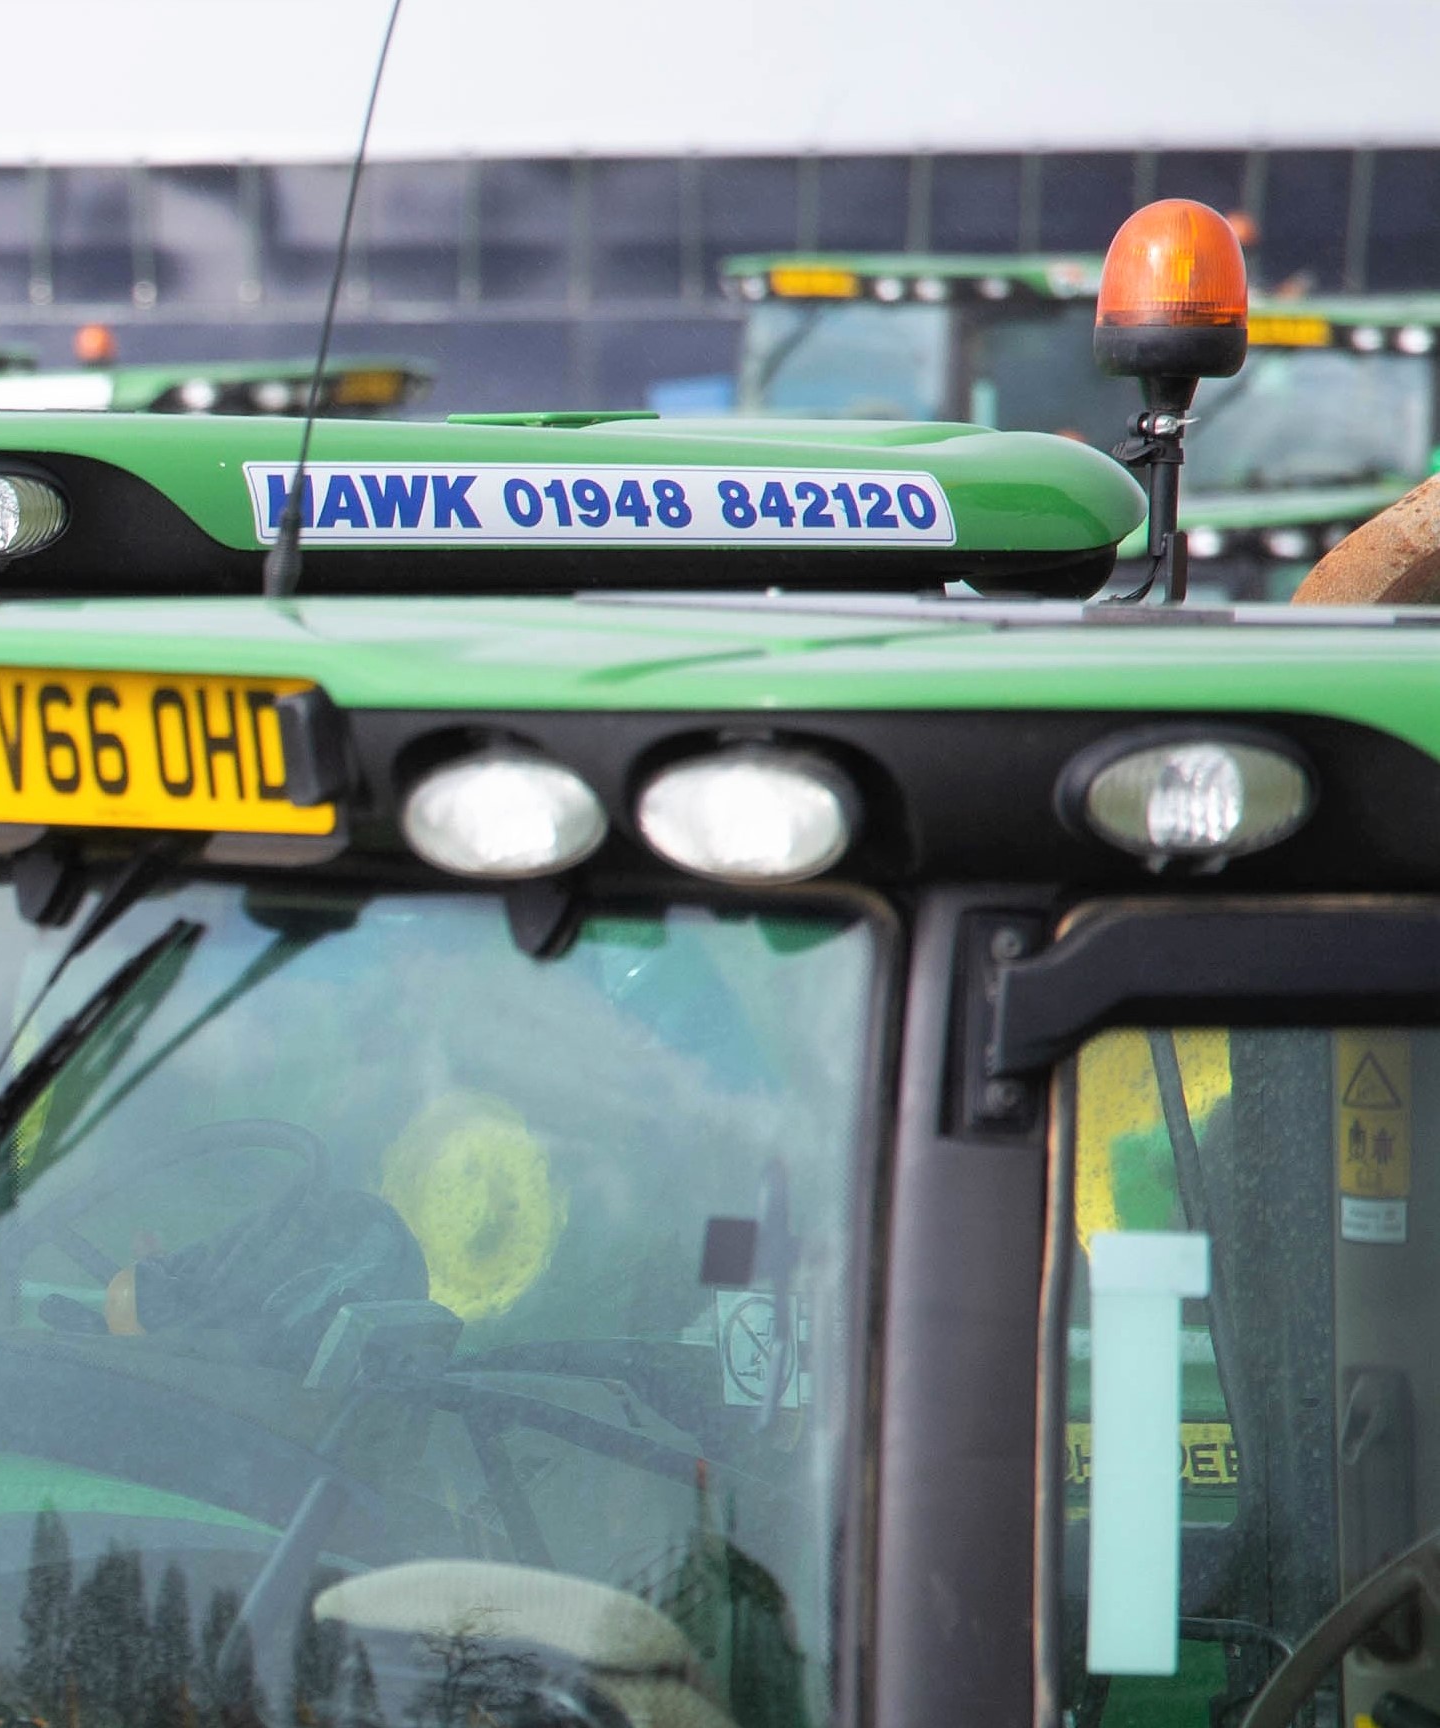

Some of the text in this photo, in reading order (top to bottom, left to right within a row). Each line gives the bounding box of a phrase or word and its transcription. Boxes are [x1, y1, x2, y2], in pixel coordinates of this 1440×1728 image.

[267, 475, 937, 529] HAWK 01948 842120
[152, 689, 289, 801] OHD
